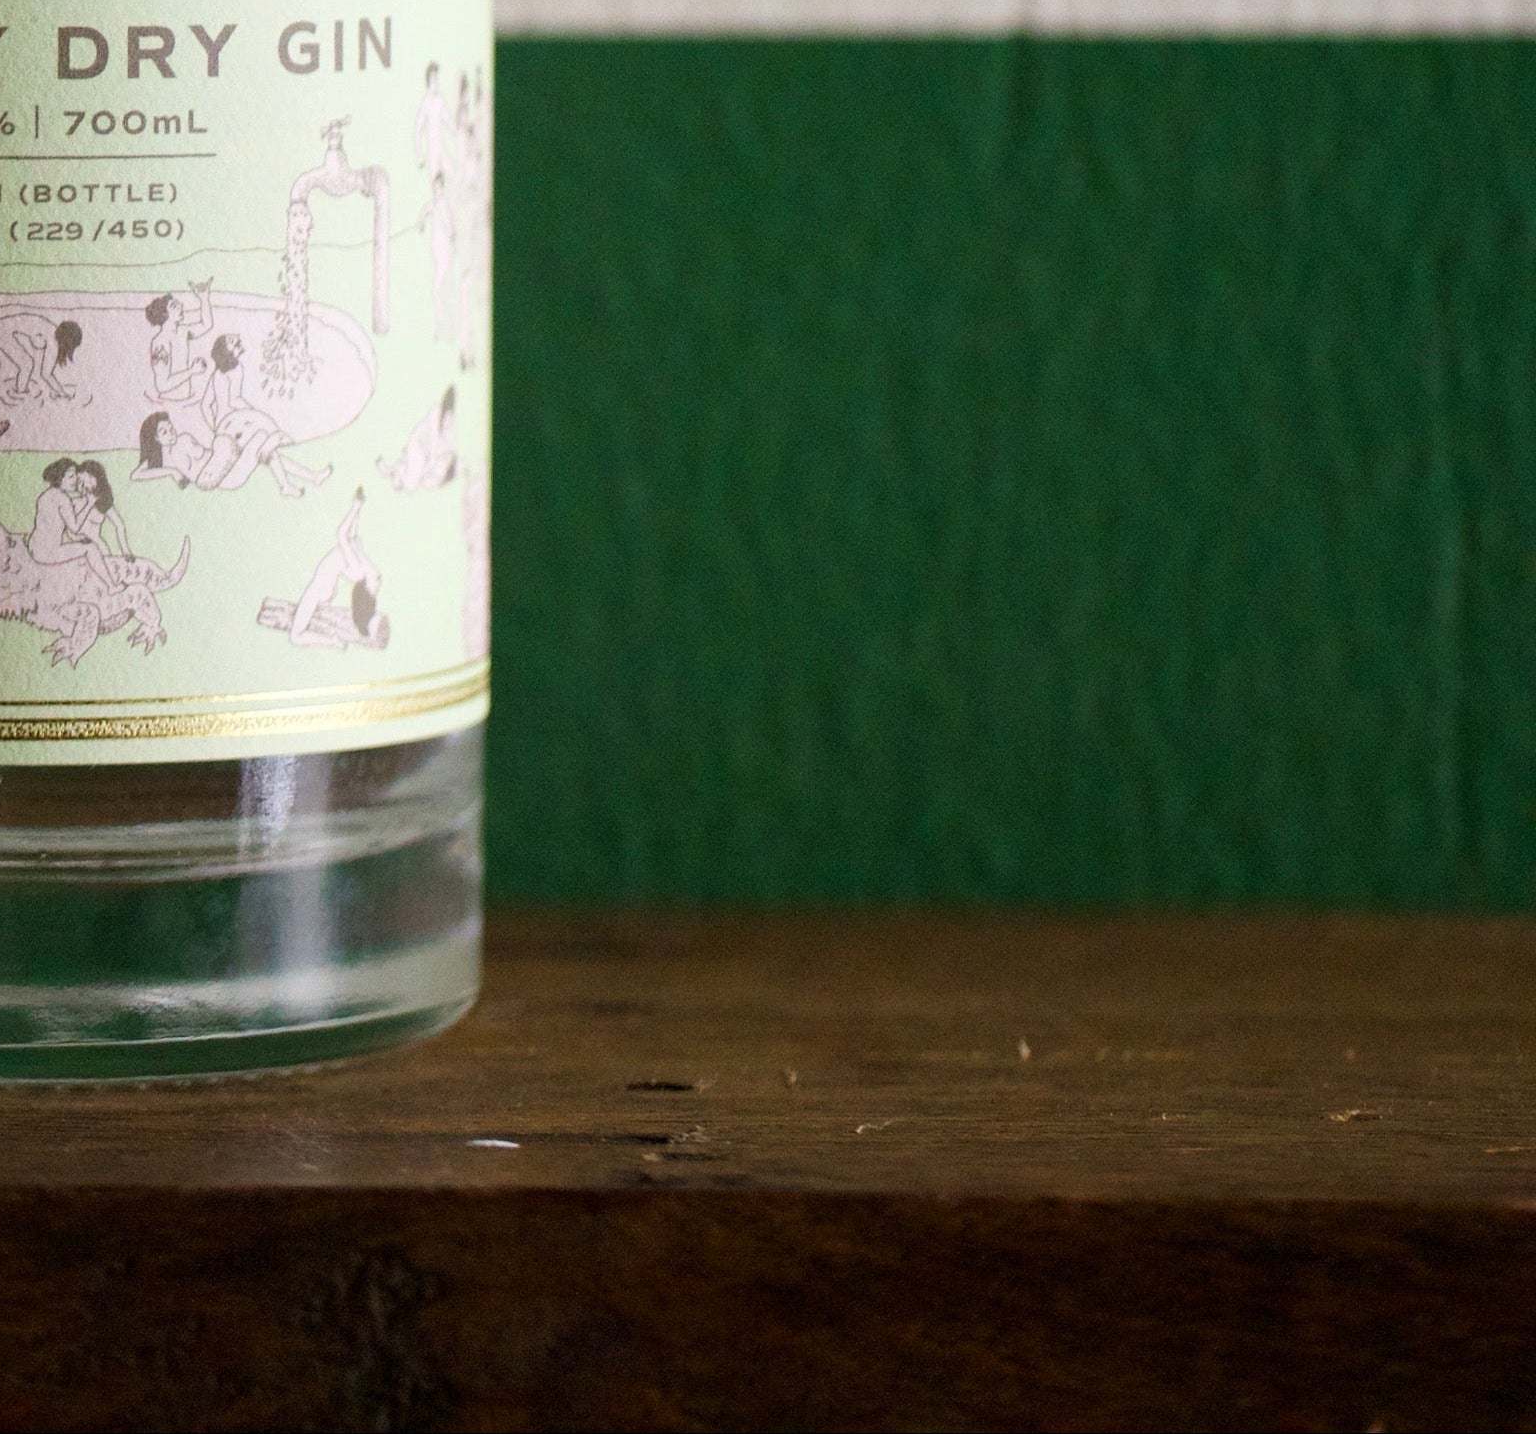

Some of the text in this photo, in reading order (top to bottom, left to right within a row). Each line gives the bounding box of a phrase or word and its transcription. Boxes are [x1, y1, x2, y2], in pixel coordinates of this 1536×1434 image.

[56, 23, 238, 78] DRY
[277, 17, 394, 73] GIN
[63, 108, 208, 135] 700mL
[18, 182, 178, 206] (BOTTLE)
